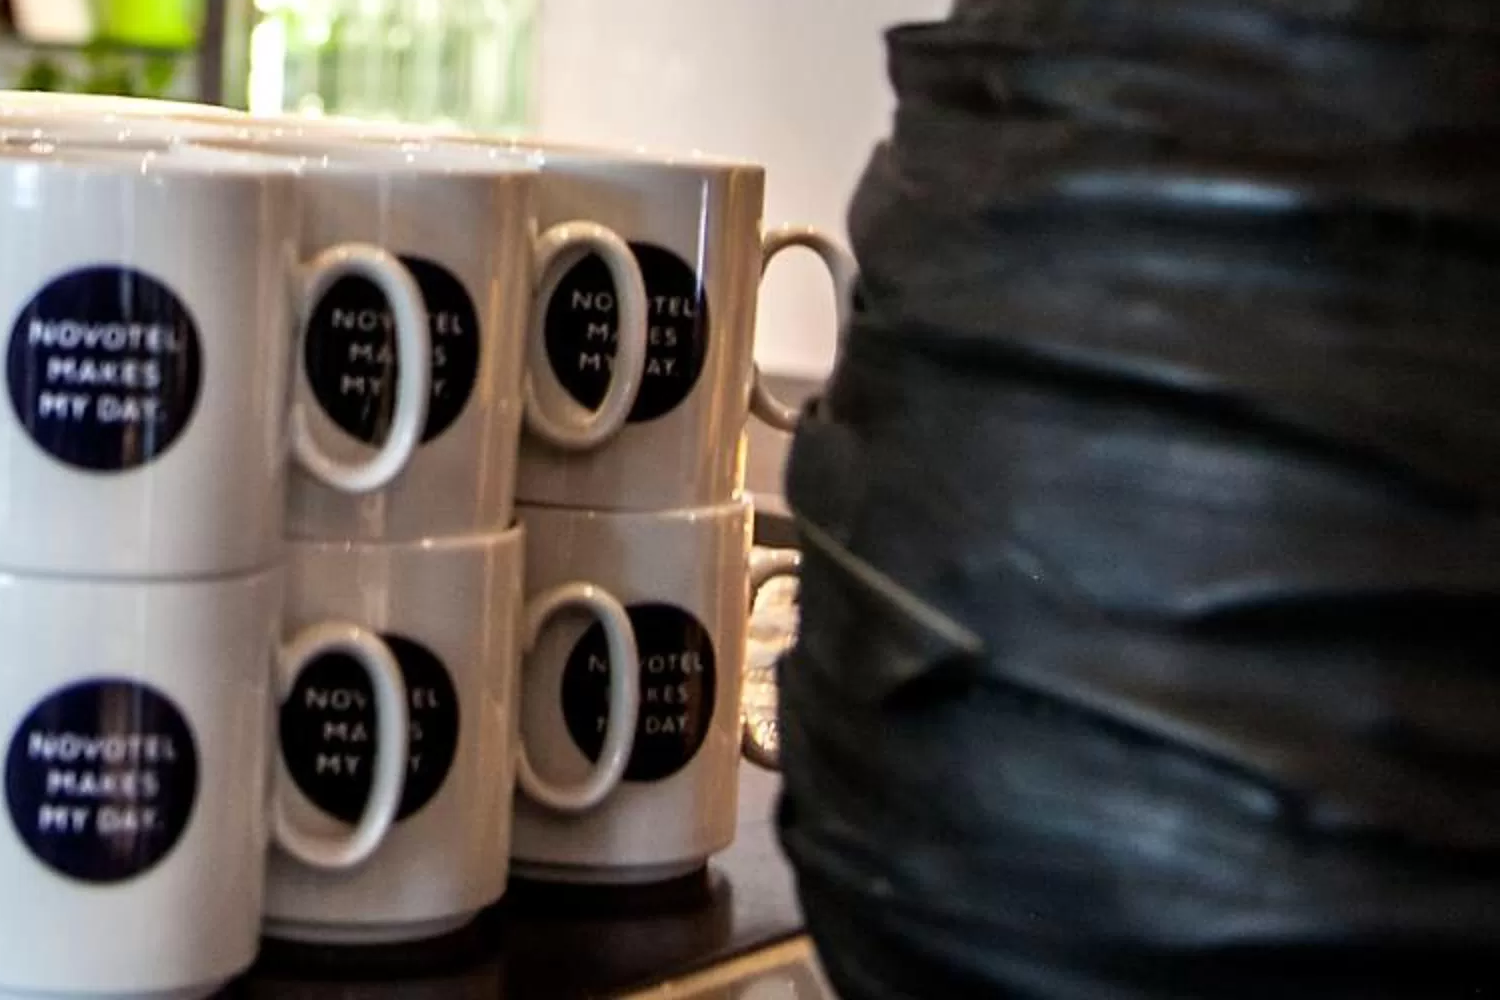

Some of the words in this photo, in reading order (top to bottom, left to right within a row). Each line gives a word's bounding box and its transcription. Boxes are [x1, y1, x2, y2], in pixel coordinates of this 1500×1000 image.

[571, 289, 696, 318] NOTEL
[28, 317, 180, 353] NOVOTEL
[587, 323, 677, 347] MES
[349, 343, 447, 367] MAS
[47, 356, 160, 388] MAKES
[340, 375, 381, 396] MY
[38, 390, 91, 421] MY
[304, 687, 440, 711] NOVEL
[323, 721, 423, 742] MAS
[316, 753, 360, 776] MY
